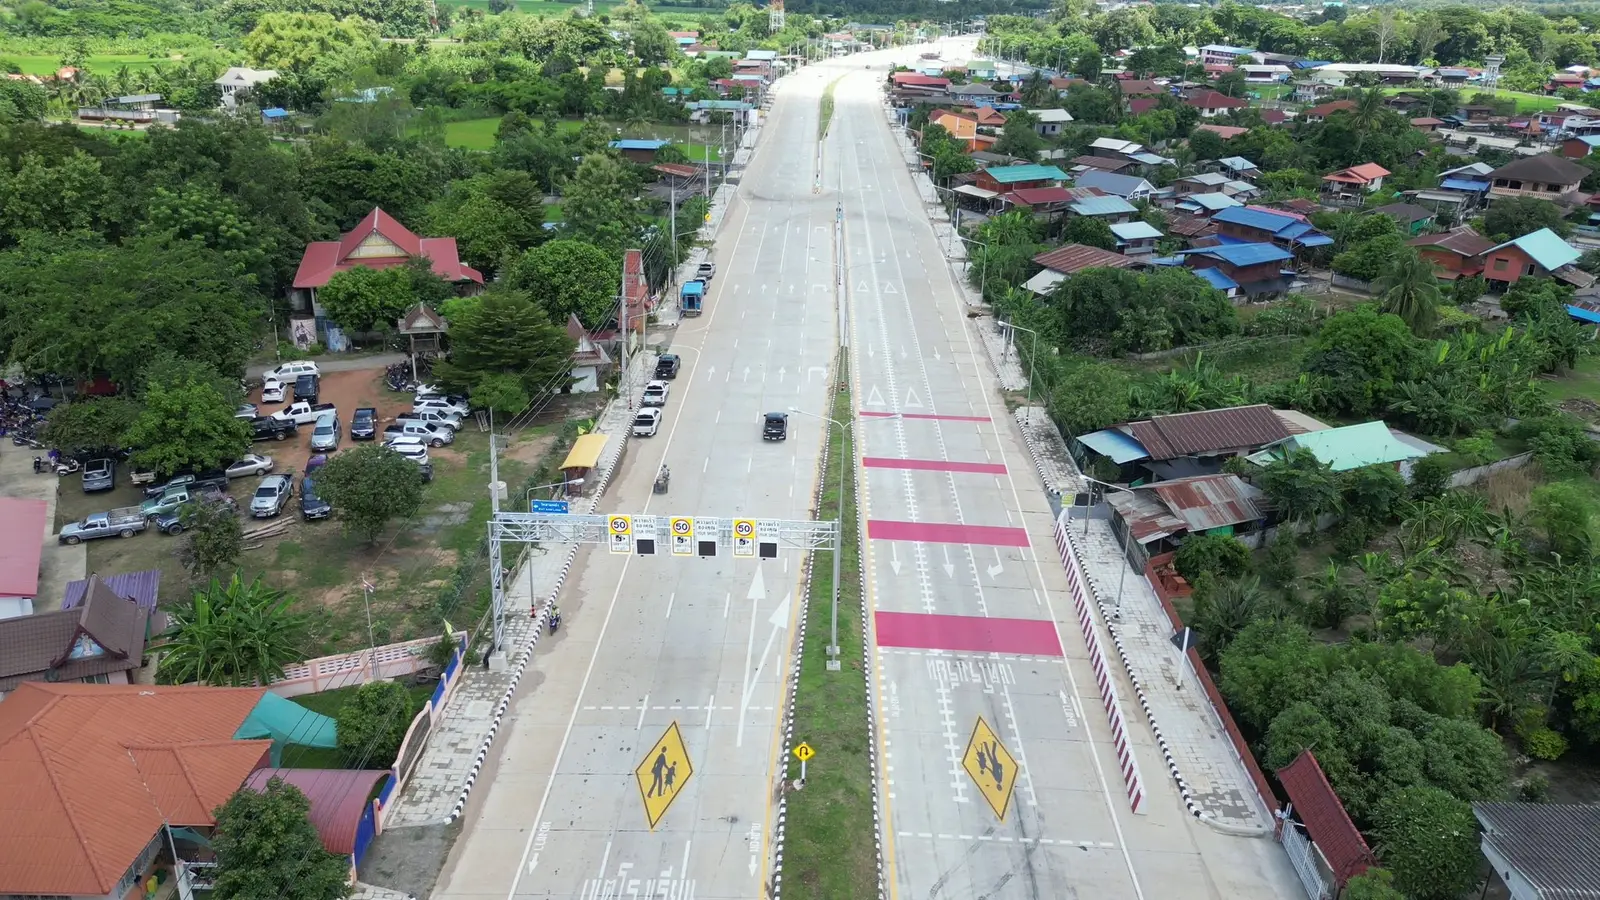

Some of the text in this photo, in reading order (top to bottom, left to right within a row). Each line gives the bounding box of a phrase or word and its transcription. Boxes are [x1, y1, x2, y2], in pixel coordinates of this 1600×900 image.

[613, 521, 626, 529] 50
[675, 523, 688, 531] 50
[738, 524, 750, 532] 50
[926, 659, 1016, 694] เขตโรงเรียน
